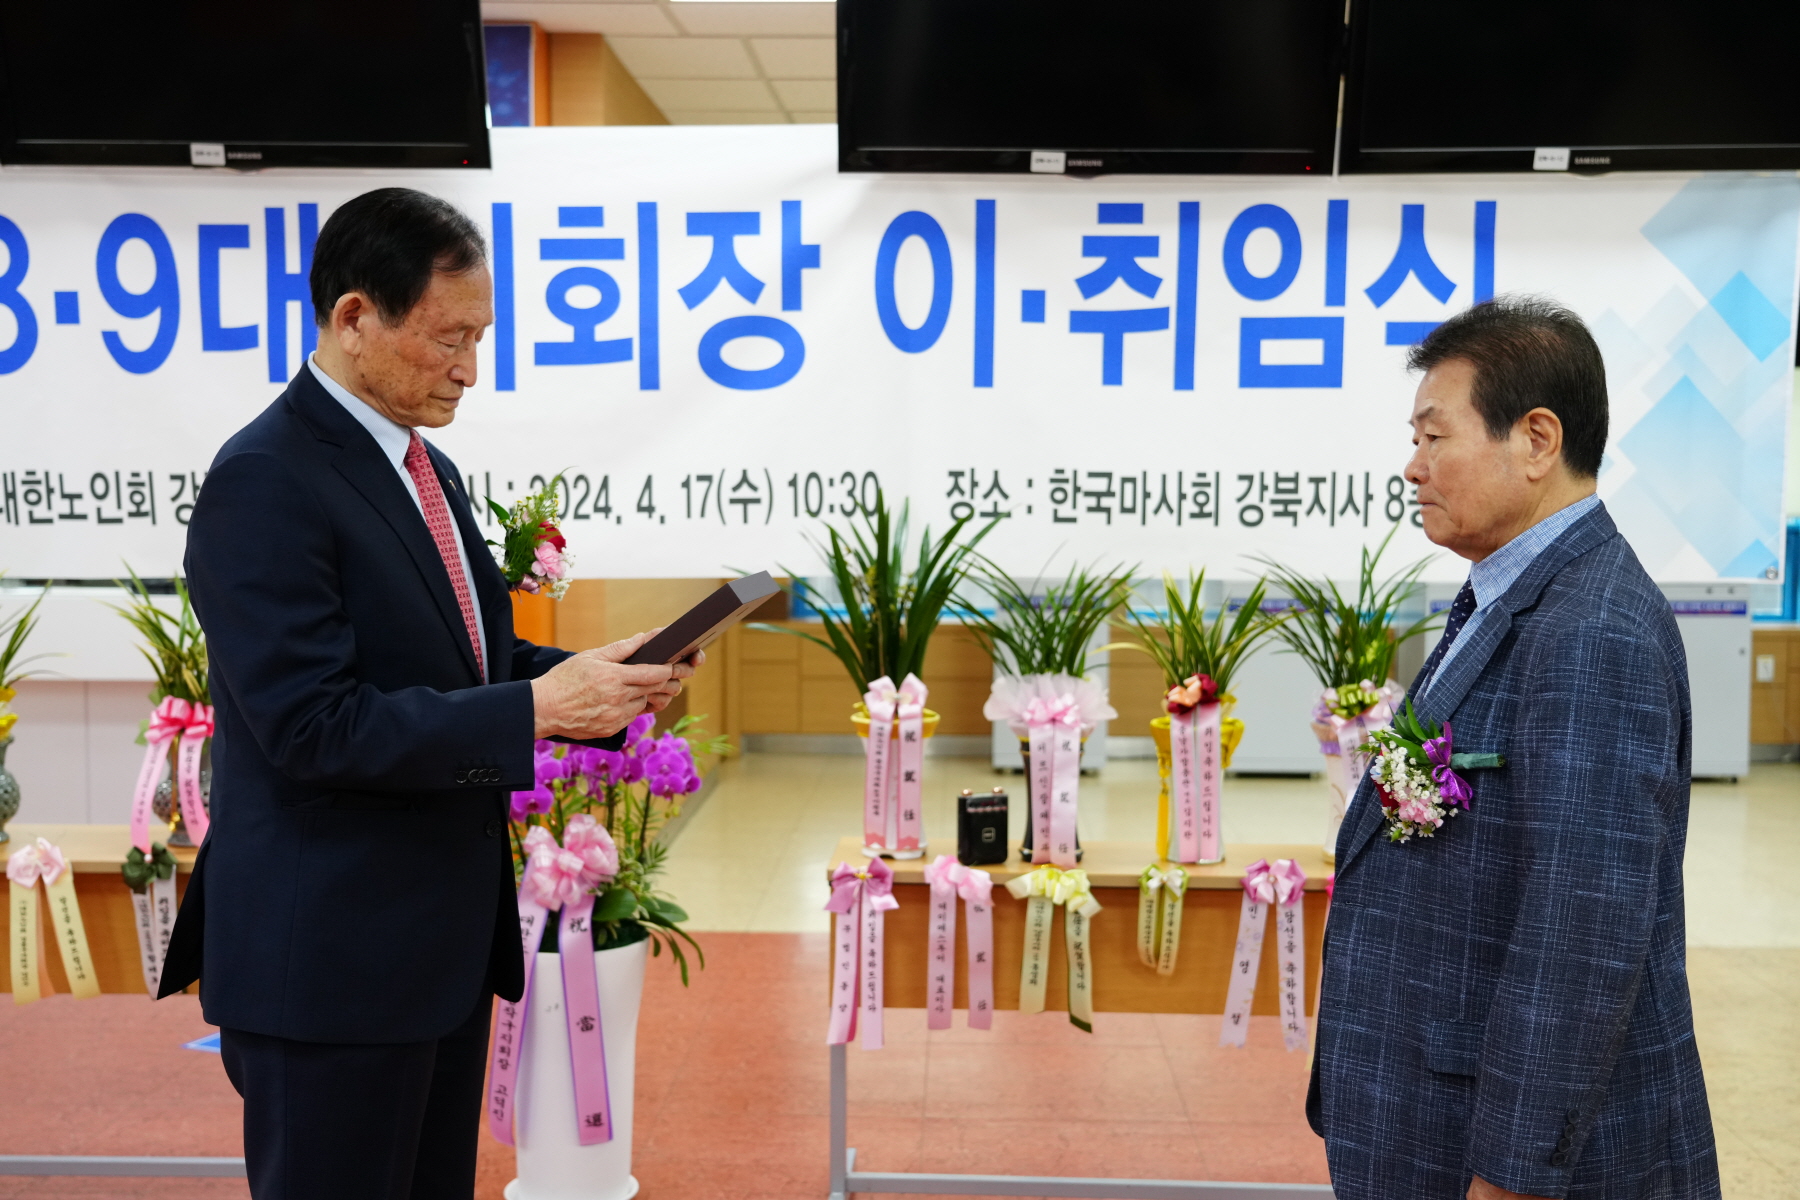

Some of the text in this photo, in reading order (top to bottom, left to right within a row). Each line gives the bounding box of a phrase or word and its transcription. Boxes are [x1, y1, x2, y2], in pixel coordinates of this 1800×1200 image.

[490, 199, 821, 391] 회장
[681, 468, 774, 525] 17(수)
[788, 471, 879, 518] 10:30
[946, 468, 1011, 522] 장소
[1049, 468, 1220, 526] 한국마사회
[1236, 471, 1374, 527] 강북지사
[1284, 909, 1300, 1033] 당선을 축하합니다
